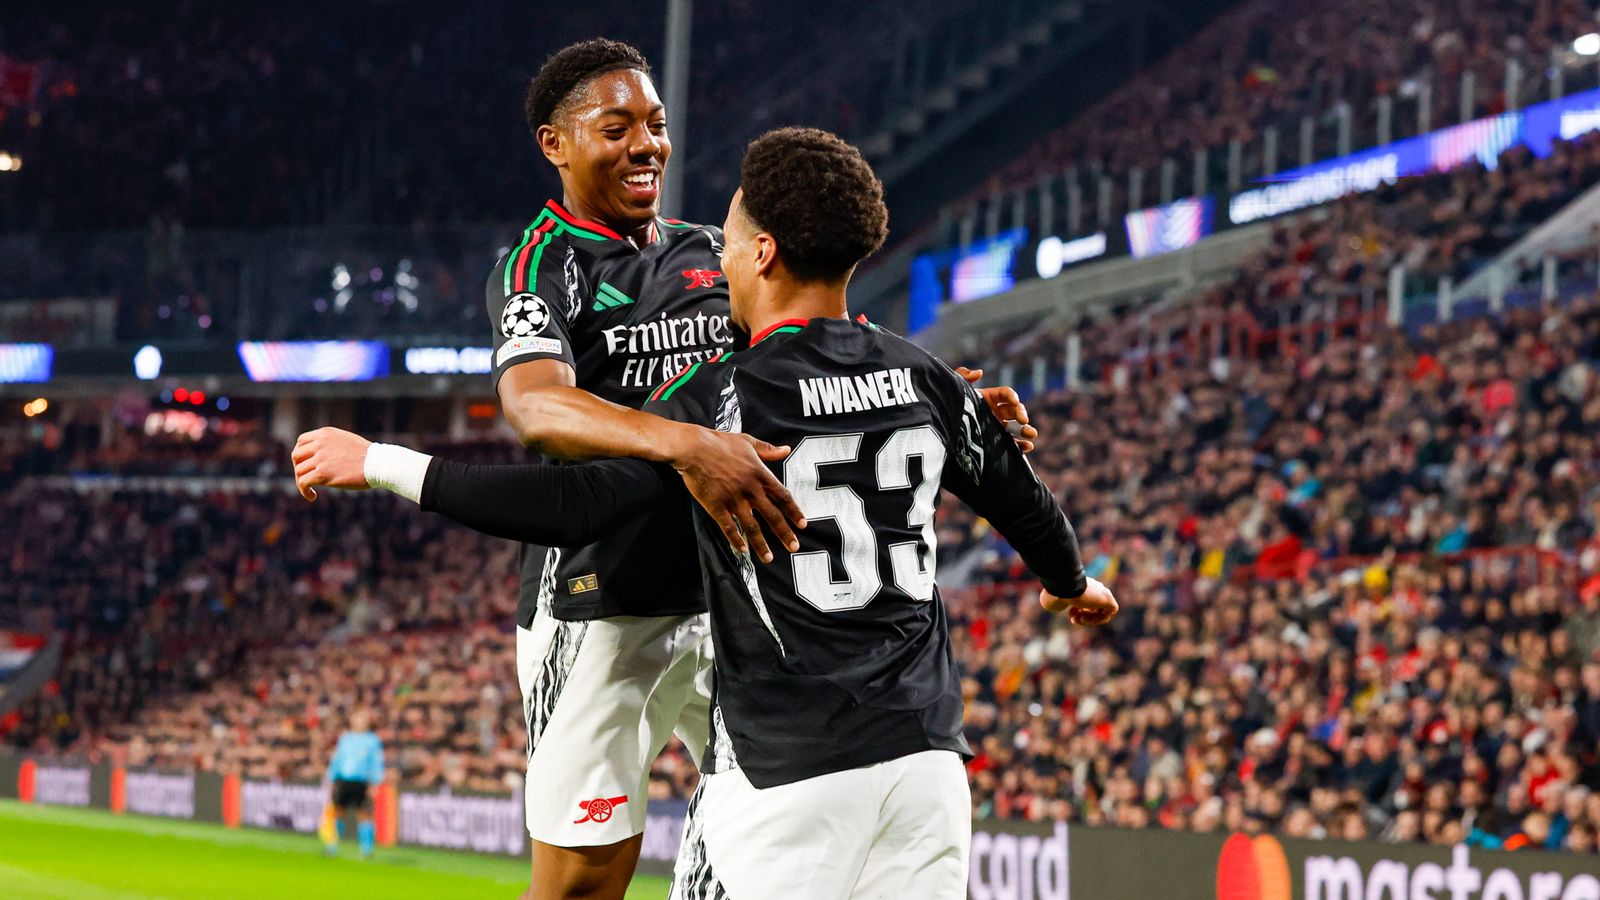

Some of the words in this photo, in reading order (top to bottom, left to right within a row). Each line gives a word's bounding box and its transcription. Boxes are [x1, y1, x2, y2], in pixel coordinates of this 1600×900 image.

[498, 340, 560, 359] UNDATION
[601, 310, 735, 356] Emirates
[621, 357, 659, 387] FLY
[798, 367, 920, 417] NWANERI
[783, 424, 948, 612] 53
[1303, 842, 1600, 900] mast
